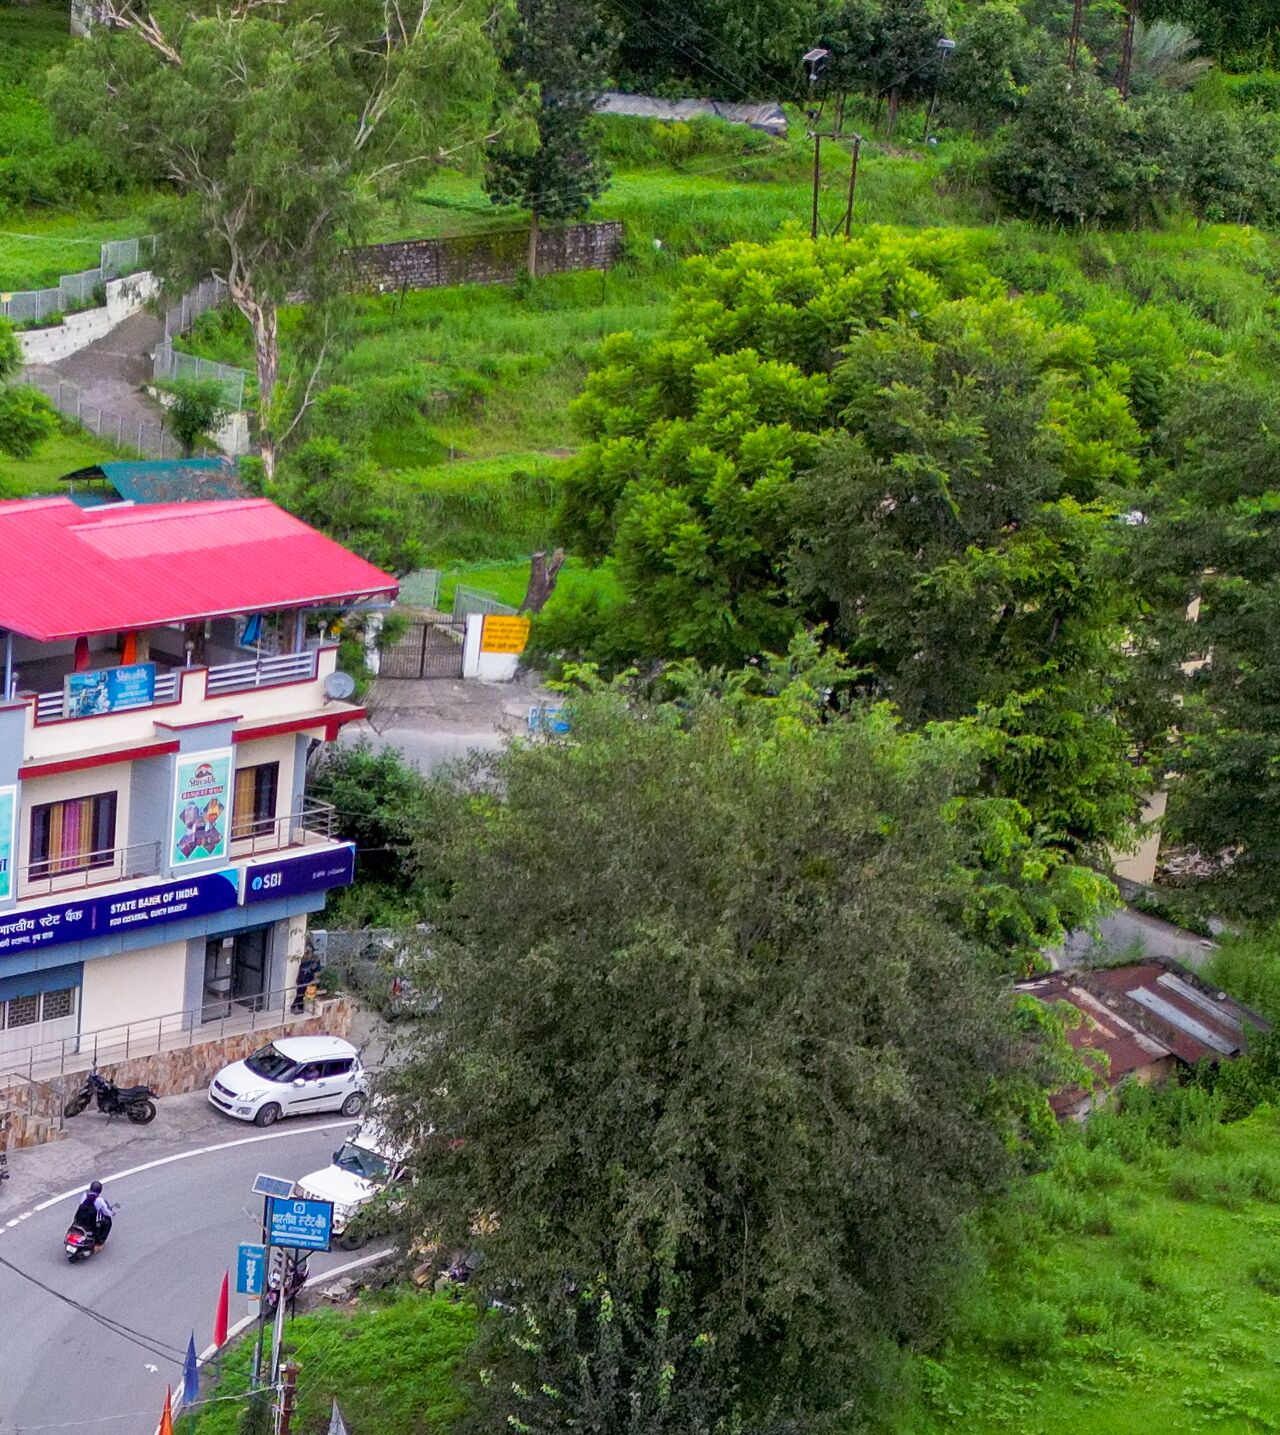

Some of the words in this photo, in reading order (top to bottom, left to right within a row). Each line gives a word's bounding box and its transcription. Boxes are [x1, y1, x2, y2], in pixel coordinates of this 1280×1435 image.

[263, 872, 282, 889] SBI
[110, 901, 136, 915] STATE
[138, 896, 161, 909] BANK
[163, 891, 174, 903] OF
[175, 886, 199, 902] INDIA
[39, 912, 61, 928] स्टेट
